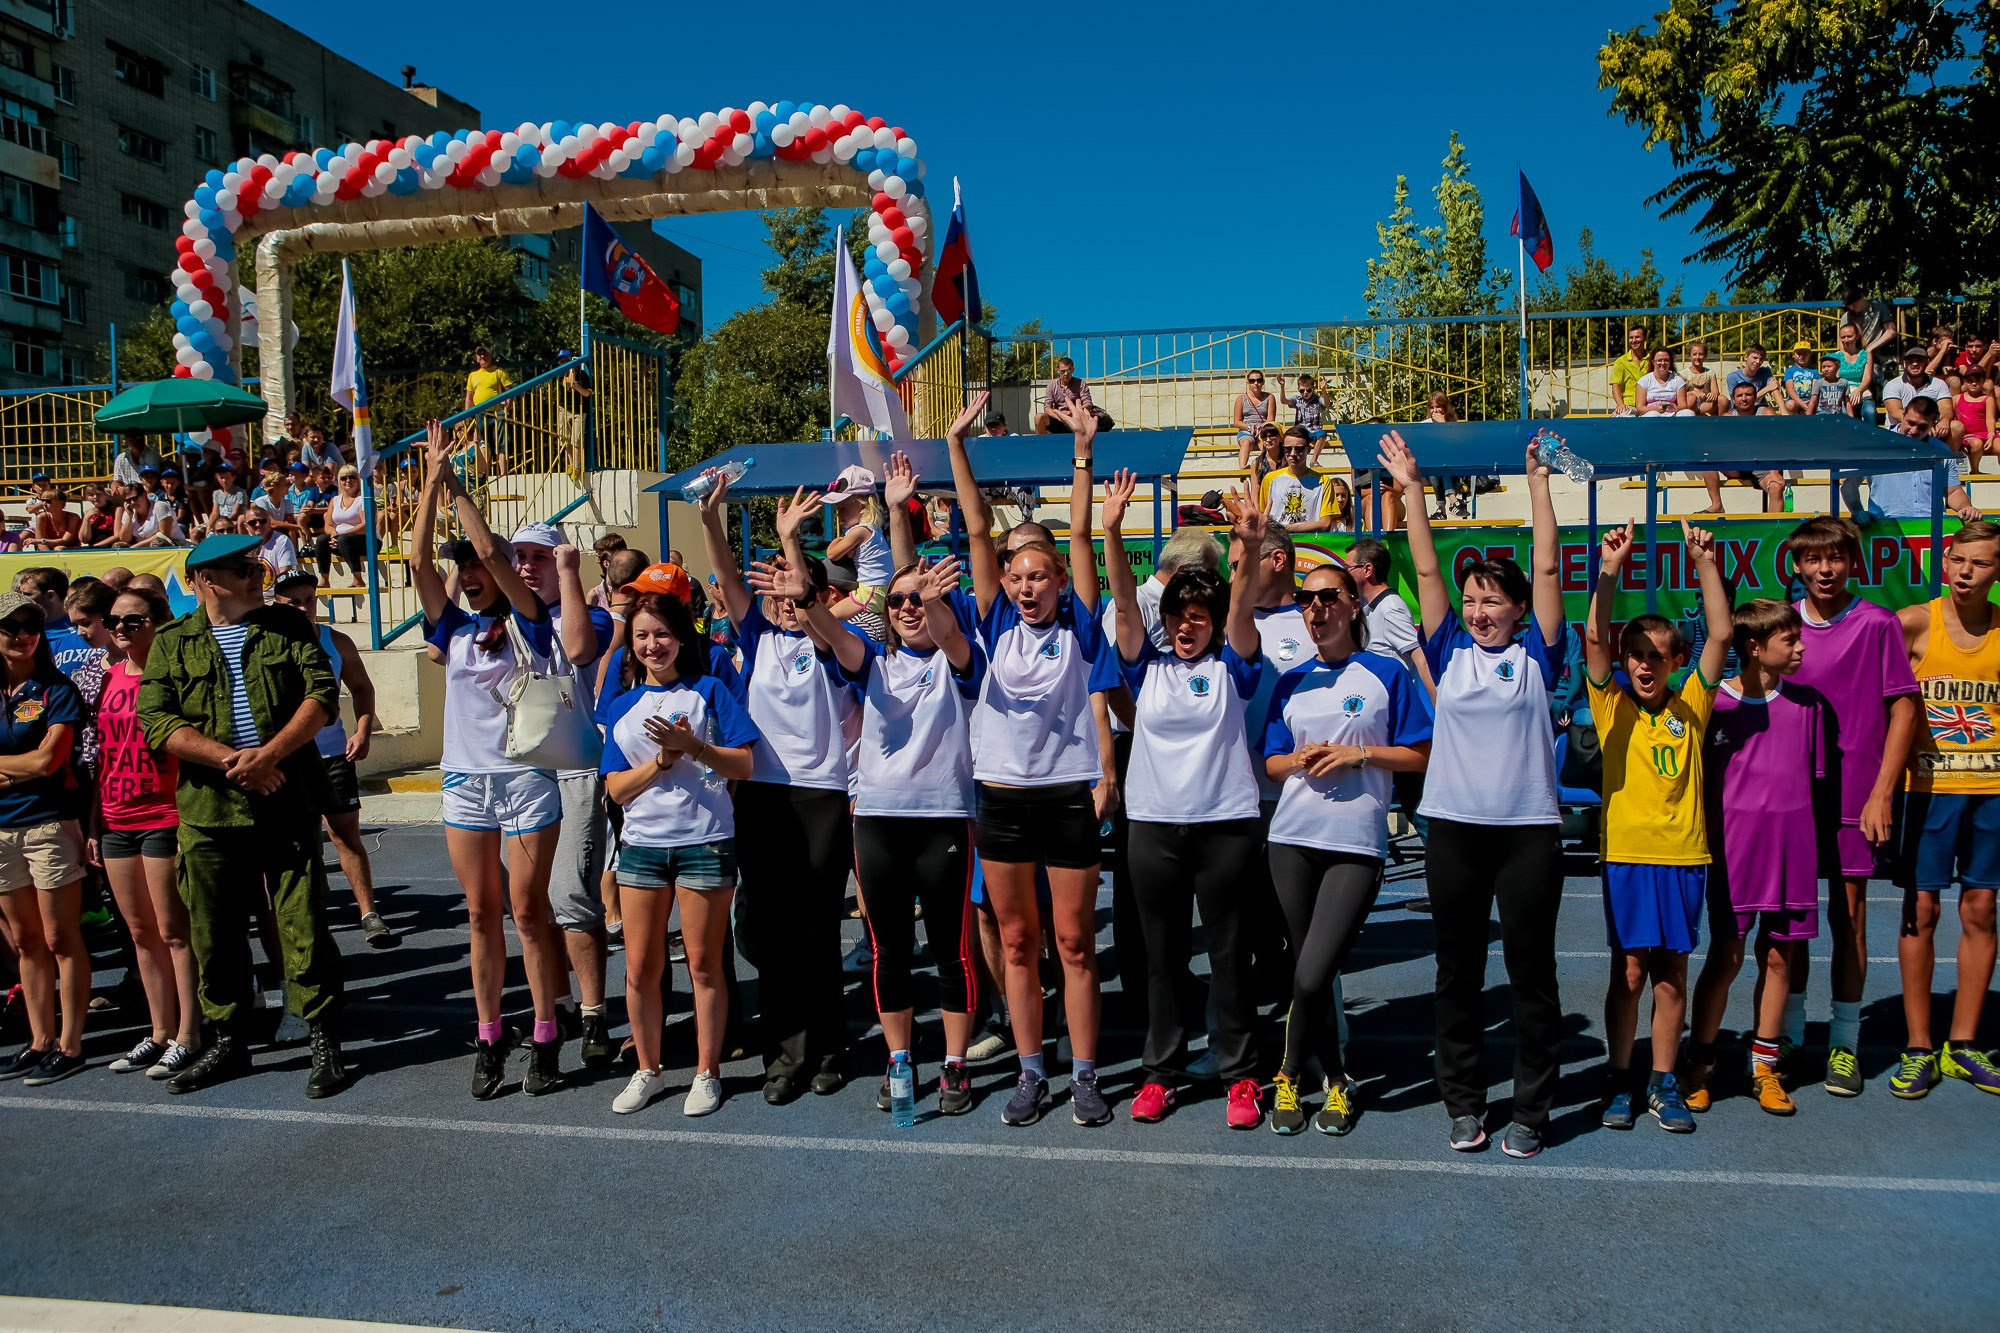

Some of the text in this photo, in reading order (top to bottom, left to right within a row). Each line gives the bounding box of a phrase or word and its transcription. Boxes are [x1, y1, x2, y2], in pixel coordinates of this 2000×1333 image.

[1528, 538, 1761, 593] ЕЕЛЫХ
[54, 648, 107, 668] BOXI
[1923, 680, 2000, 703] LONDON
[1651, 745, 1678, 776] 10
